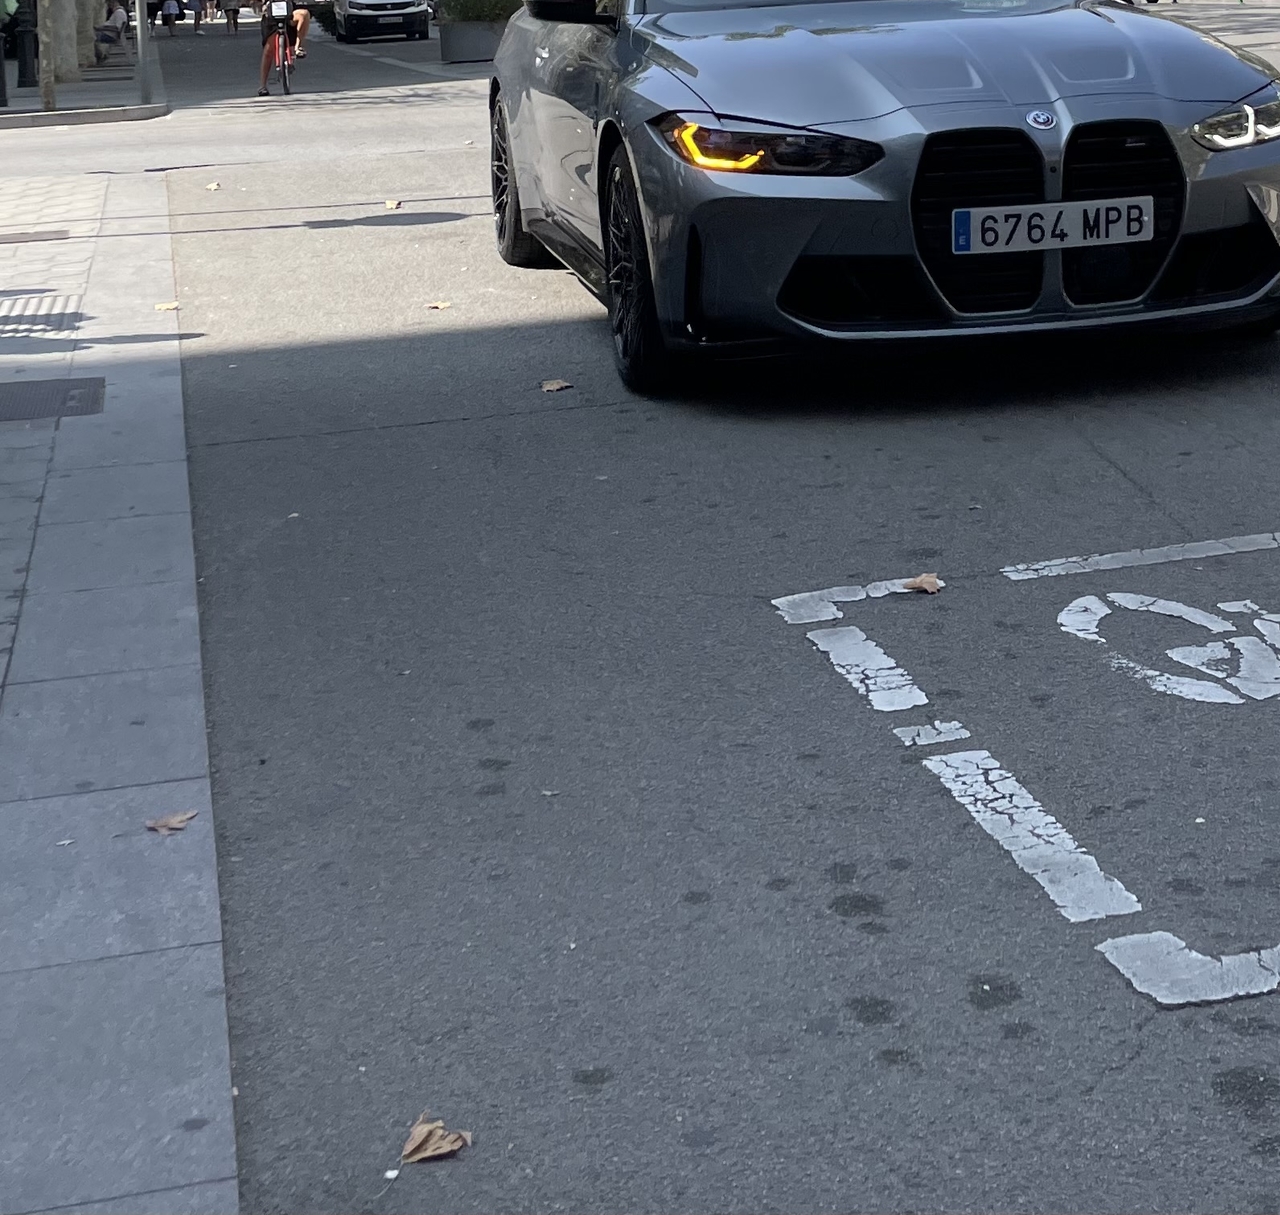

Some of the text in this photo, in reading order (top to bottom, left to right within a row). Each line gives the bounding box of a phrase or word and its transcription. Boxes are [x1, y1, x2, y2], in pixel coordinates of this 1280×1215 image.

[958, 204, 1144, 247] E 6764 MPB
